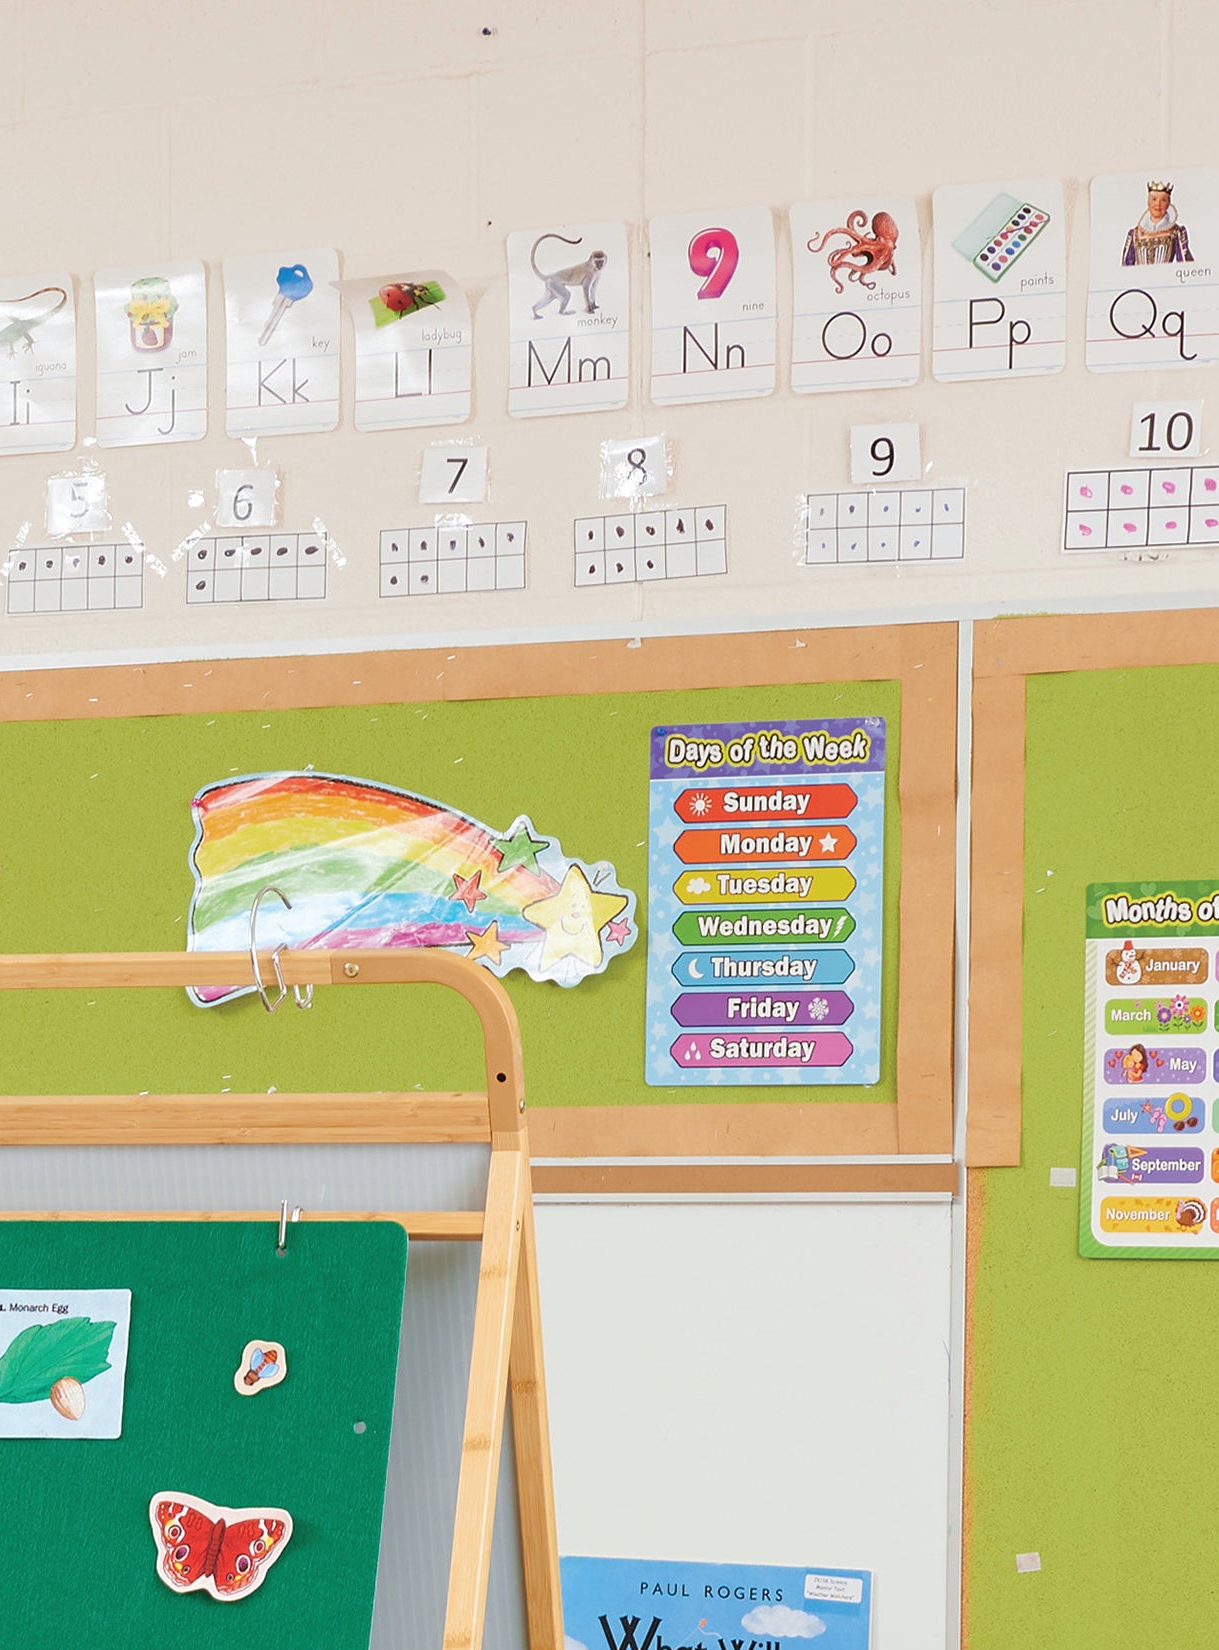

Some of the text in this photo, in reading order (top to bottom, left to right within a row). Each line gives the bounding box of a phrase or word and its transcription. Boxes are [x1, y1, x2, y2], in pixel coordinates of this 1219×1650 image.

[1020, 273, 1055, 288] paints
[1175, 266, 1212, 283] queen
[741, 299, 765, 311] nine
[866, 288, 911, 304] octopus
[577, 314, 619, 329] monkey
[968, 297, 1032, 370] Pp
[1109, 288, 1198, 361] Qq
[311, 336, 331, 351] key
[421, 328, 463, 344] ladybug
[682, 322, 746, 374] Nn
[821, 311, 893, 360] Oo
[35, 359, 68, 377] iguana
[175, 347, 198, 364] jam
[527, 335, 611, 387] Mm
[256, 356, 311, 407] Kk
[124, 367, 179, 436] Jj
[1138, 411, 1195, 453] 10
[626, 447, 649, 486] 8
[869, 437, 896, 476] 9
[445, 458, 469, 494] 7
[68, 483, 91, 519] 5
[232, 484, 254, 521] 6
[668, 732, 868, 767] Days of the Week
[723, 790, 811, 815] Sunday
[720, 831, 813, 856] Monday
[716, 872, 814, 897] Tuesday
[1104, 894, 1193, 924] Months
[697, 914, 833, 939] Wednesday
[710, 955, 818, 980] Thursday
[1145, 959, 1201, 974] January
[726, 996, 800, 1022] Friday
[1111, 1008, 1152, 1021] March
[709, 1036, 816, 1062] Saturday
[1169, 1057, 1197, 1073] May
[1110, 1108, 1138, 1124] July
[1131, 1158, 1201, 1176] September
[1105, 1208, 1170, 1221] November
[9, 1303, 49, 1312] Monarch
[52, 1303, 69, 1314] Egg
[640, 1582, 785, 1602] PAUL ROGERS
